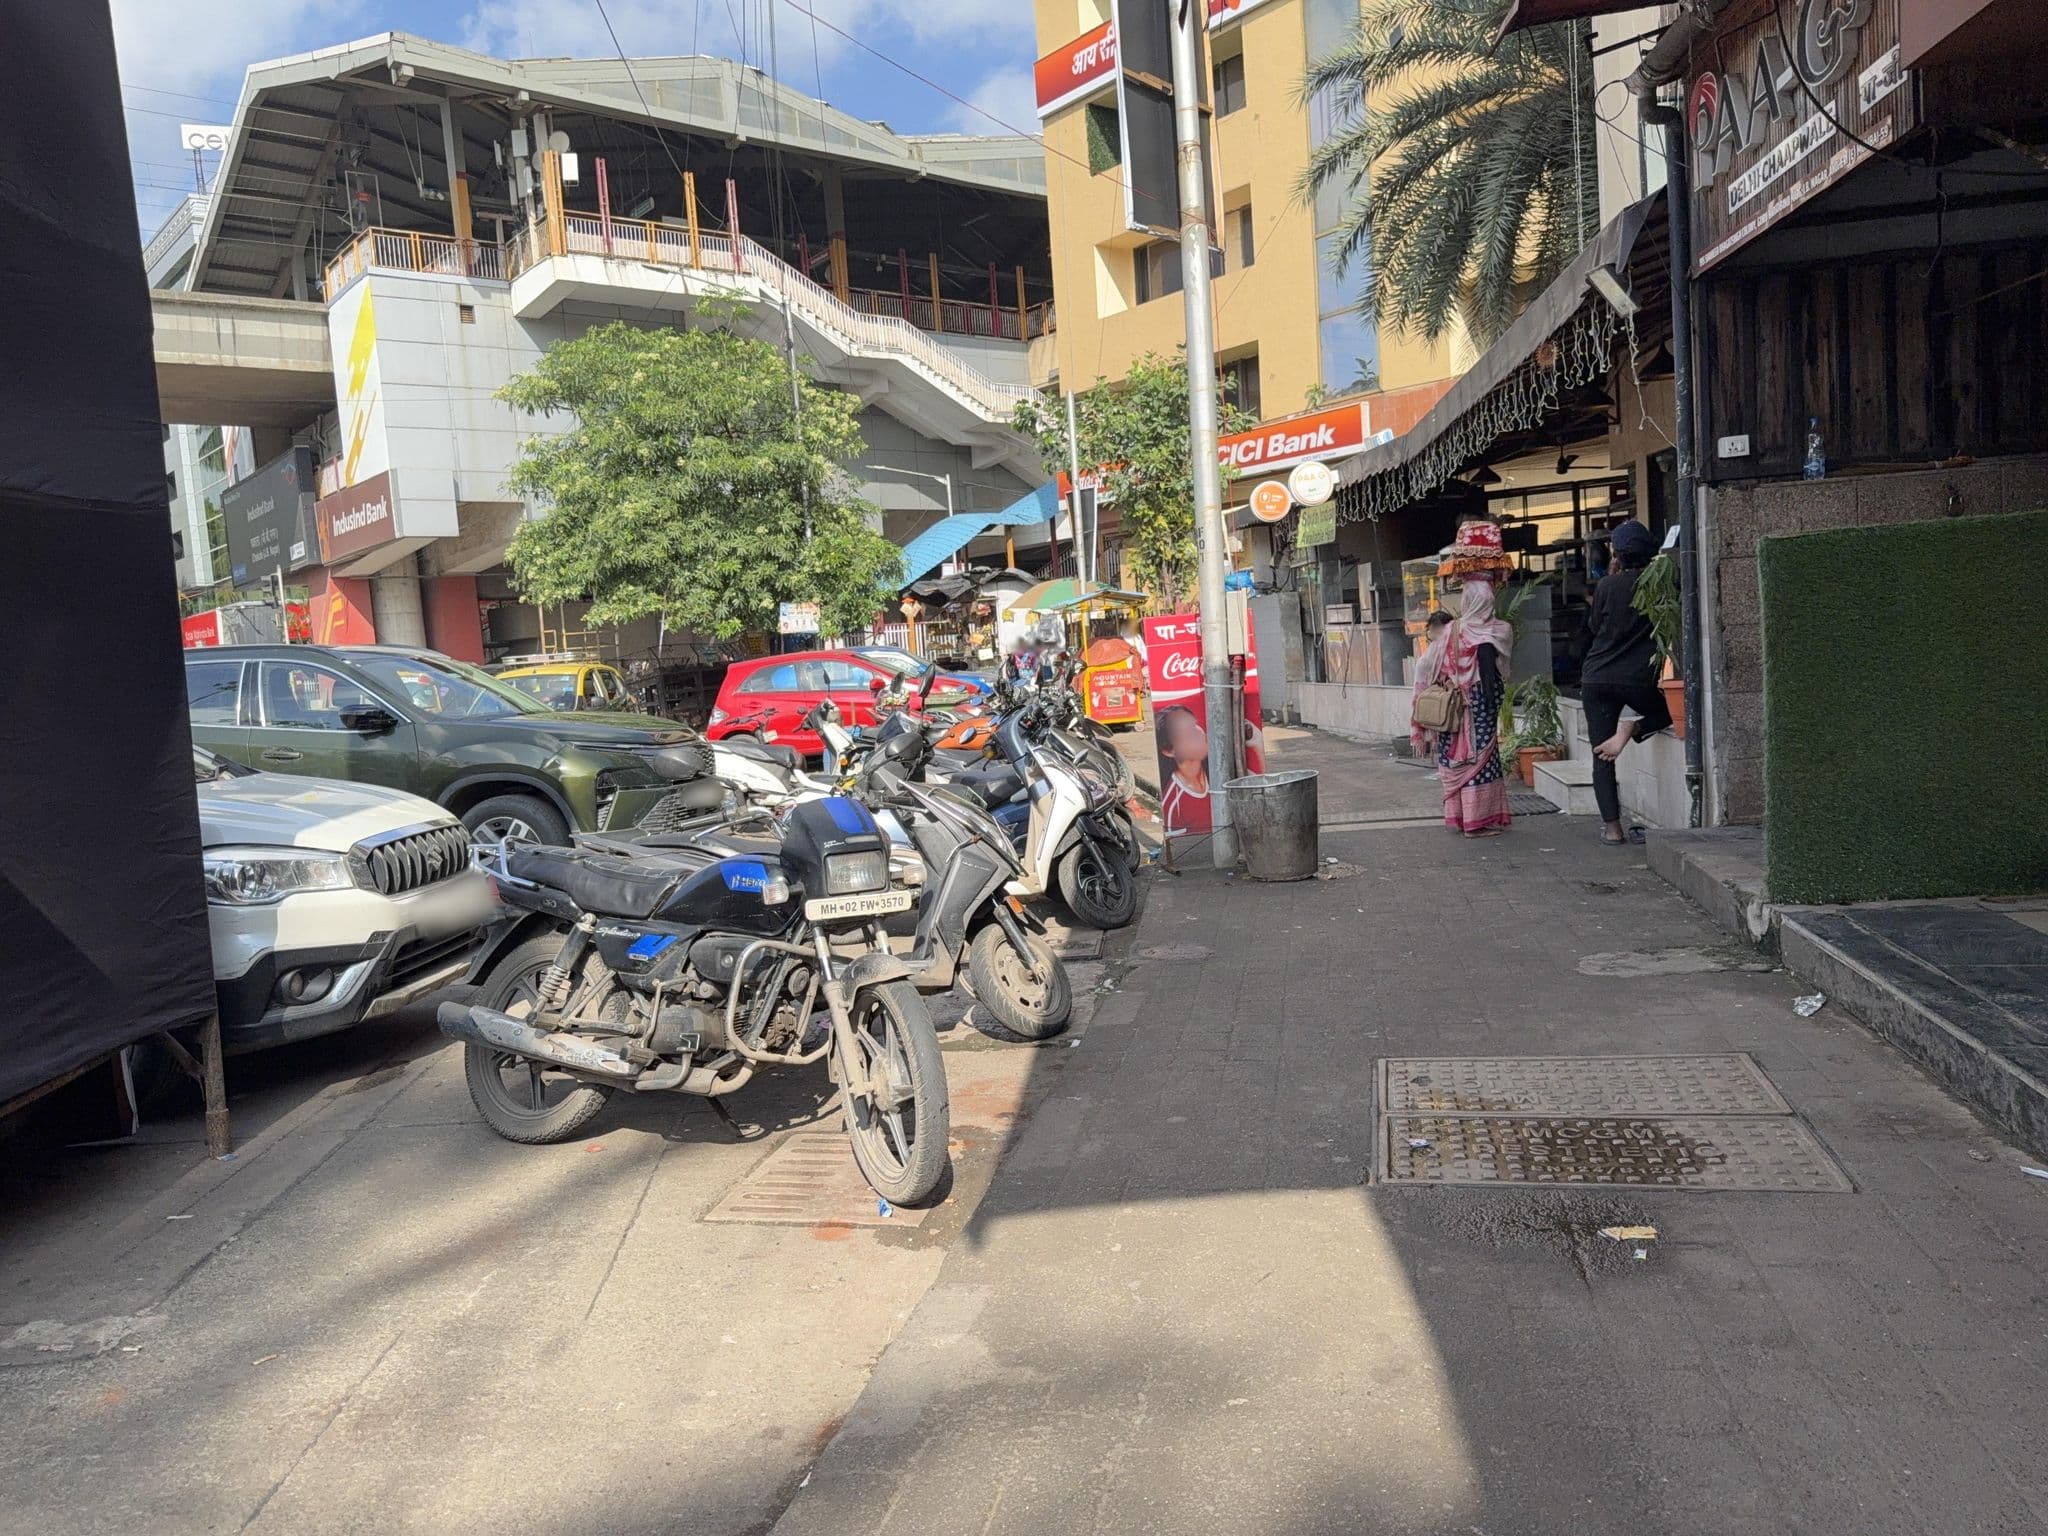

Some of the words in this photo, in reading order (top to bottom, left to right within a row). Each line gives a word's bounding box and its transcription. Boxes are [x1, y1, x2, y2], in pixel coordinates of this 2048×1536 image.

[1072, 42, 1098, 75] आय
[1217, 437, 1264, 466] CICI
[1267, 423, 1336, 458] Bank
[332, 502, 367, 537] IndusInd
[366, 495, 388, 525] Bank
[820, 904, 837, 915] MH
[845, 901, 857, 912] 02
[860, 899, 876, 911] FW
[880, 896, 904, 910] 3570
[1524, 1127, 1657, 1140] MCGM
